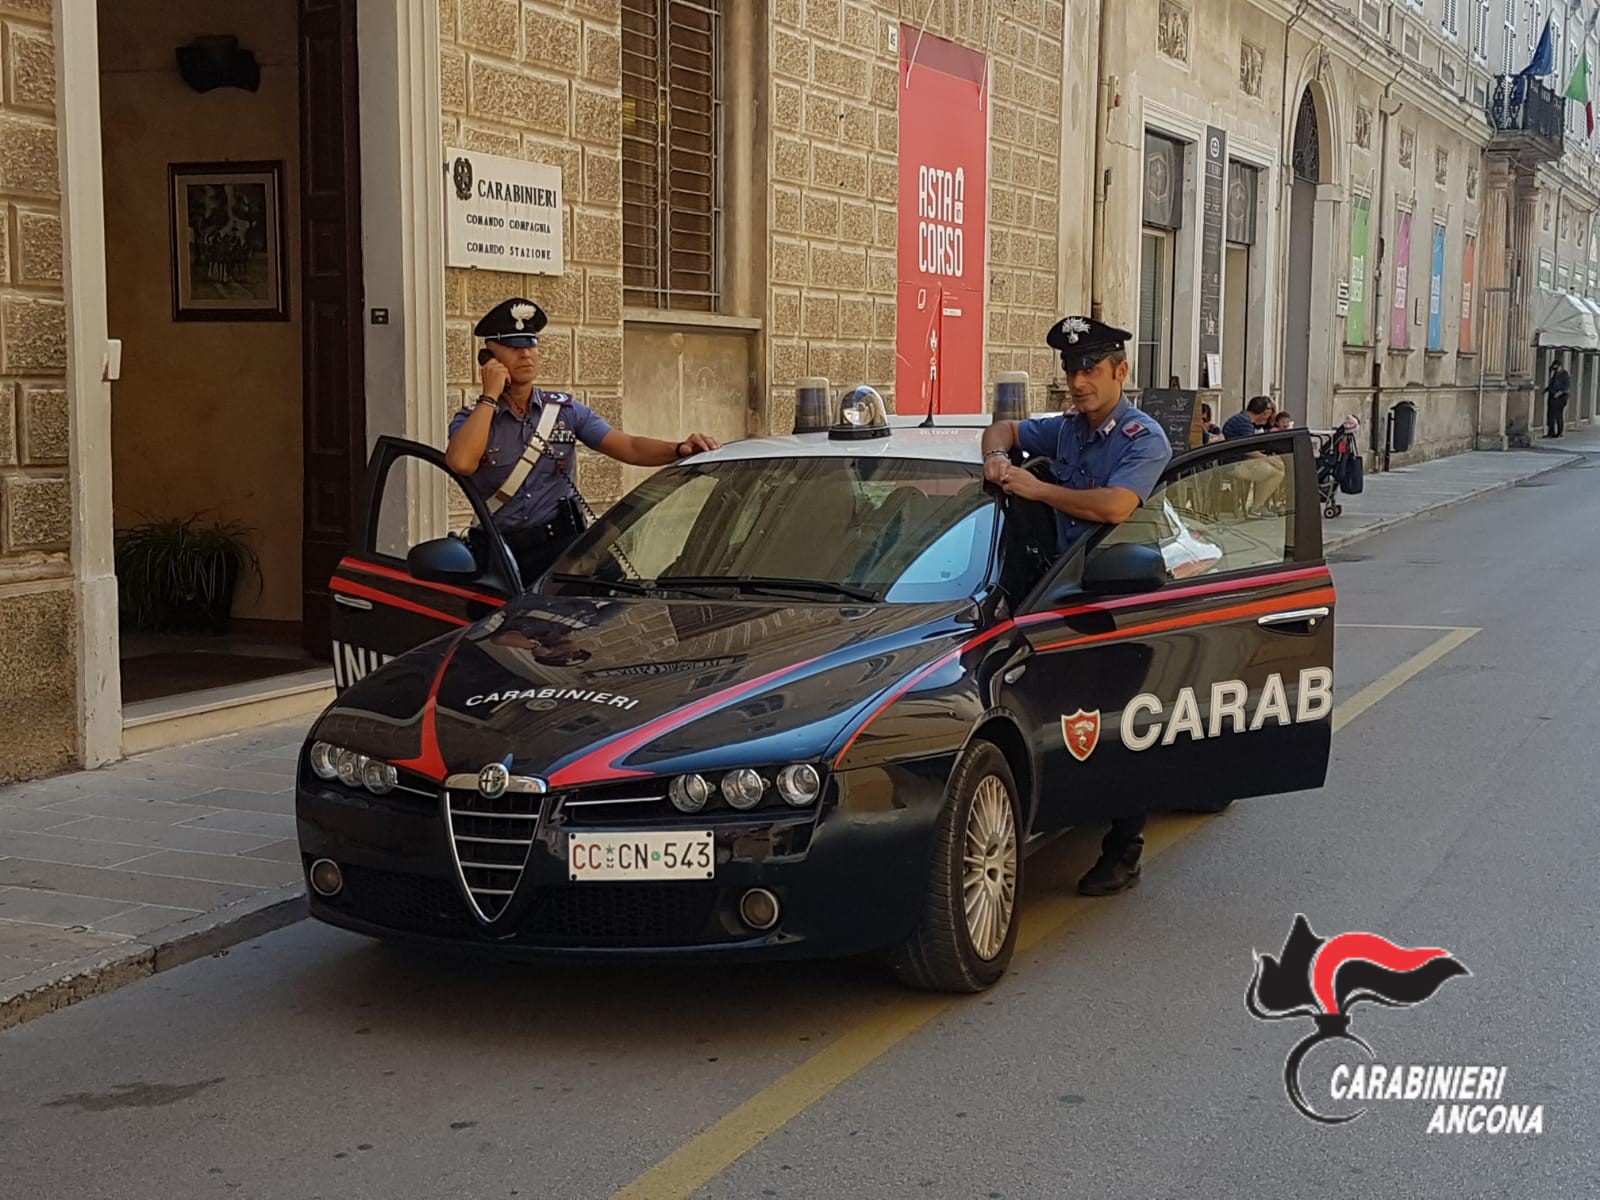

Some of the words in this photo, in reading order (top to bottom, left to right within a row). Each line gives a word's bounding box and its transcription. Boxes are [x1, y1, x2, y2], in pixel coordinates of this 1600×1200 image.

[478, 179, 557, 208] CARABINIERI
[919, 165, 953, 222] ASTA
[466, 214, 504, 228] COMANDO
[509, 220, 551, 234] COMPAGNIA
[466, 242, 505, 256] COMANDO
[509, 246, 552, 260] STAZIONE
[919, 221, 963, 278] CORSO
[465, 688, 639, 710] CARABINIERI
[1120, 666, 1333, 752] CARAB
[572, 844, 602, 869] CC
[618, 843, 649, 869] CN
[663, 842, 711, 869] 543
